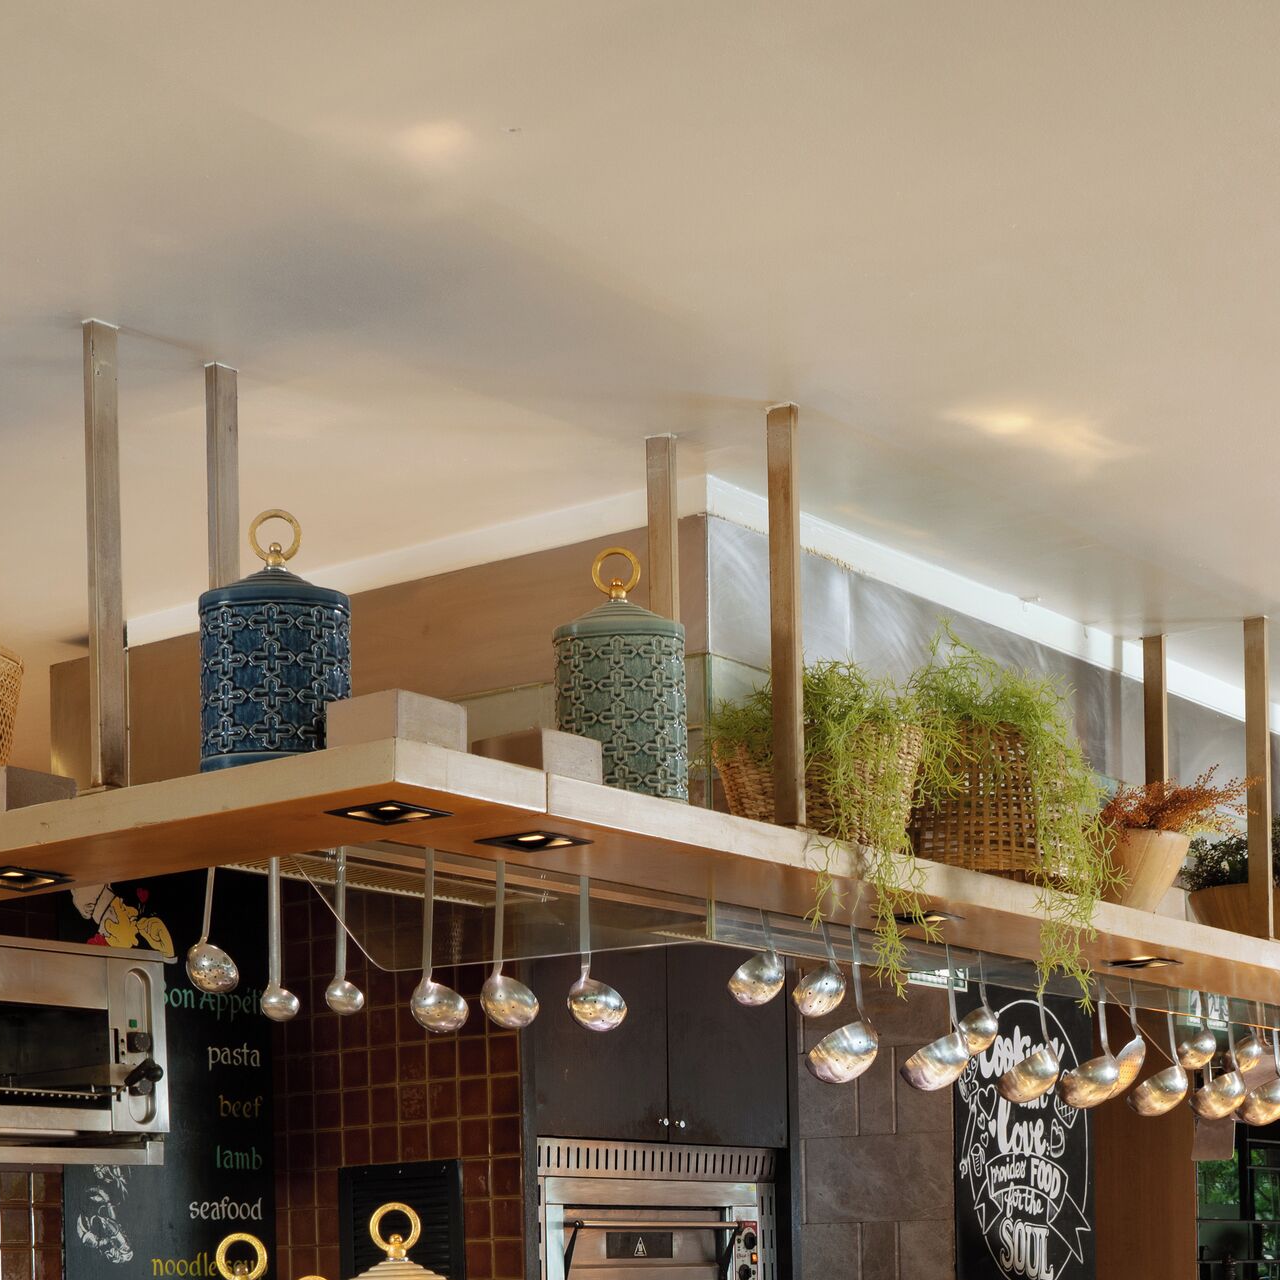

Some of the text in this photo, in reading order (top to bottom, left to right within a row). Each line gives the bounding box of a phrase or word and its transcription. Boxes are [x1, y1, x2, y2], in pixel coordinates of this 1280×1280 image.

[207, 1042, 261, 1071] pasta
[218, 1094, 263, 1118] beef
[216, 1145, 262, 1170] lamb
[1031, 1157, 1061, 1199] FOOD
[189, 1196, 262, 1220] seafood
[1004, 1181, 1044, 1218] for the
[151, 1252, 217, 1277] noodle
